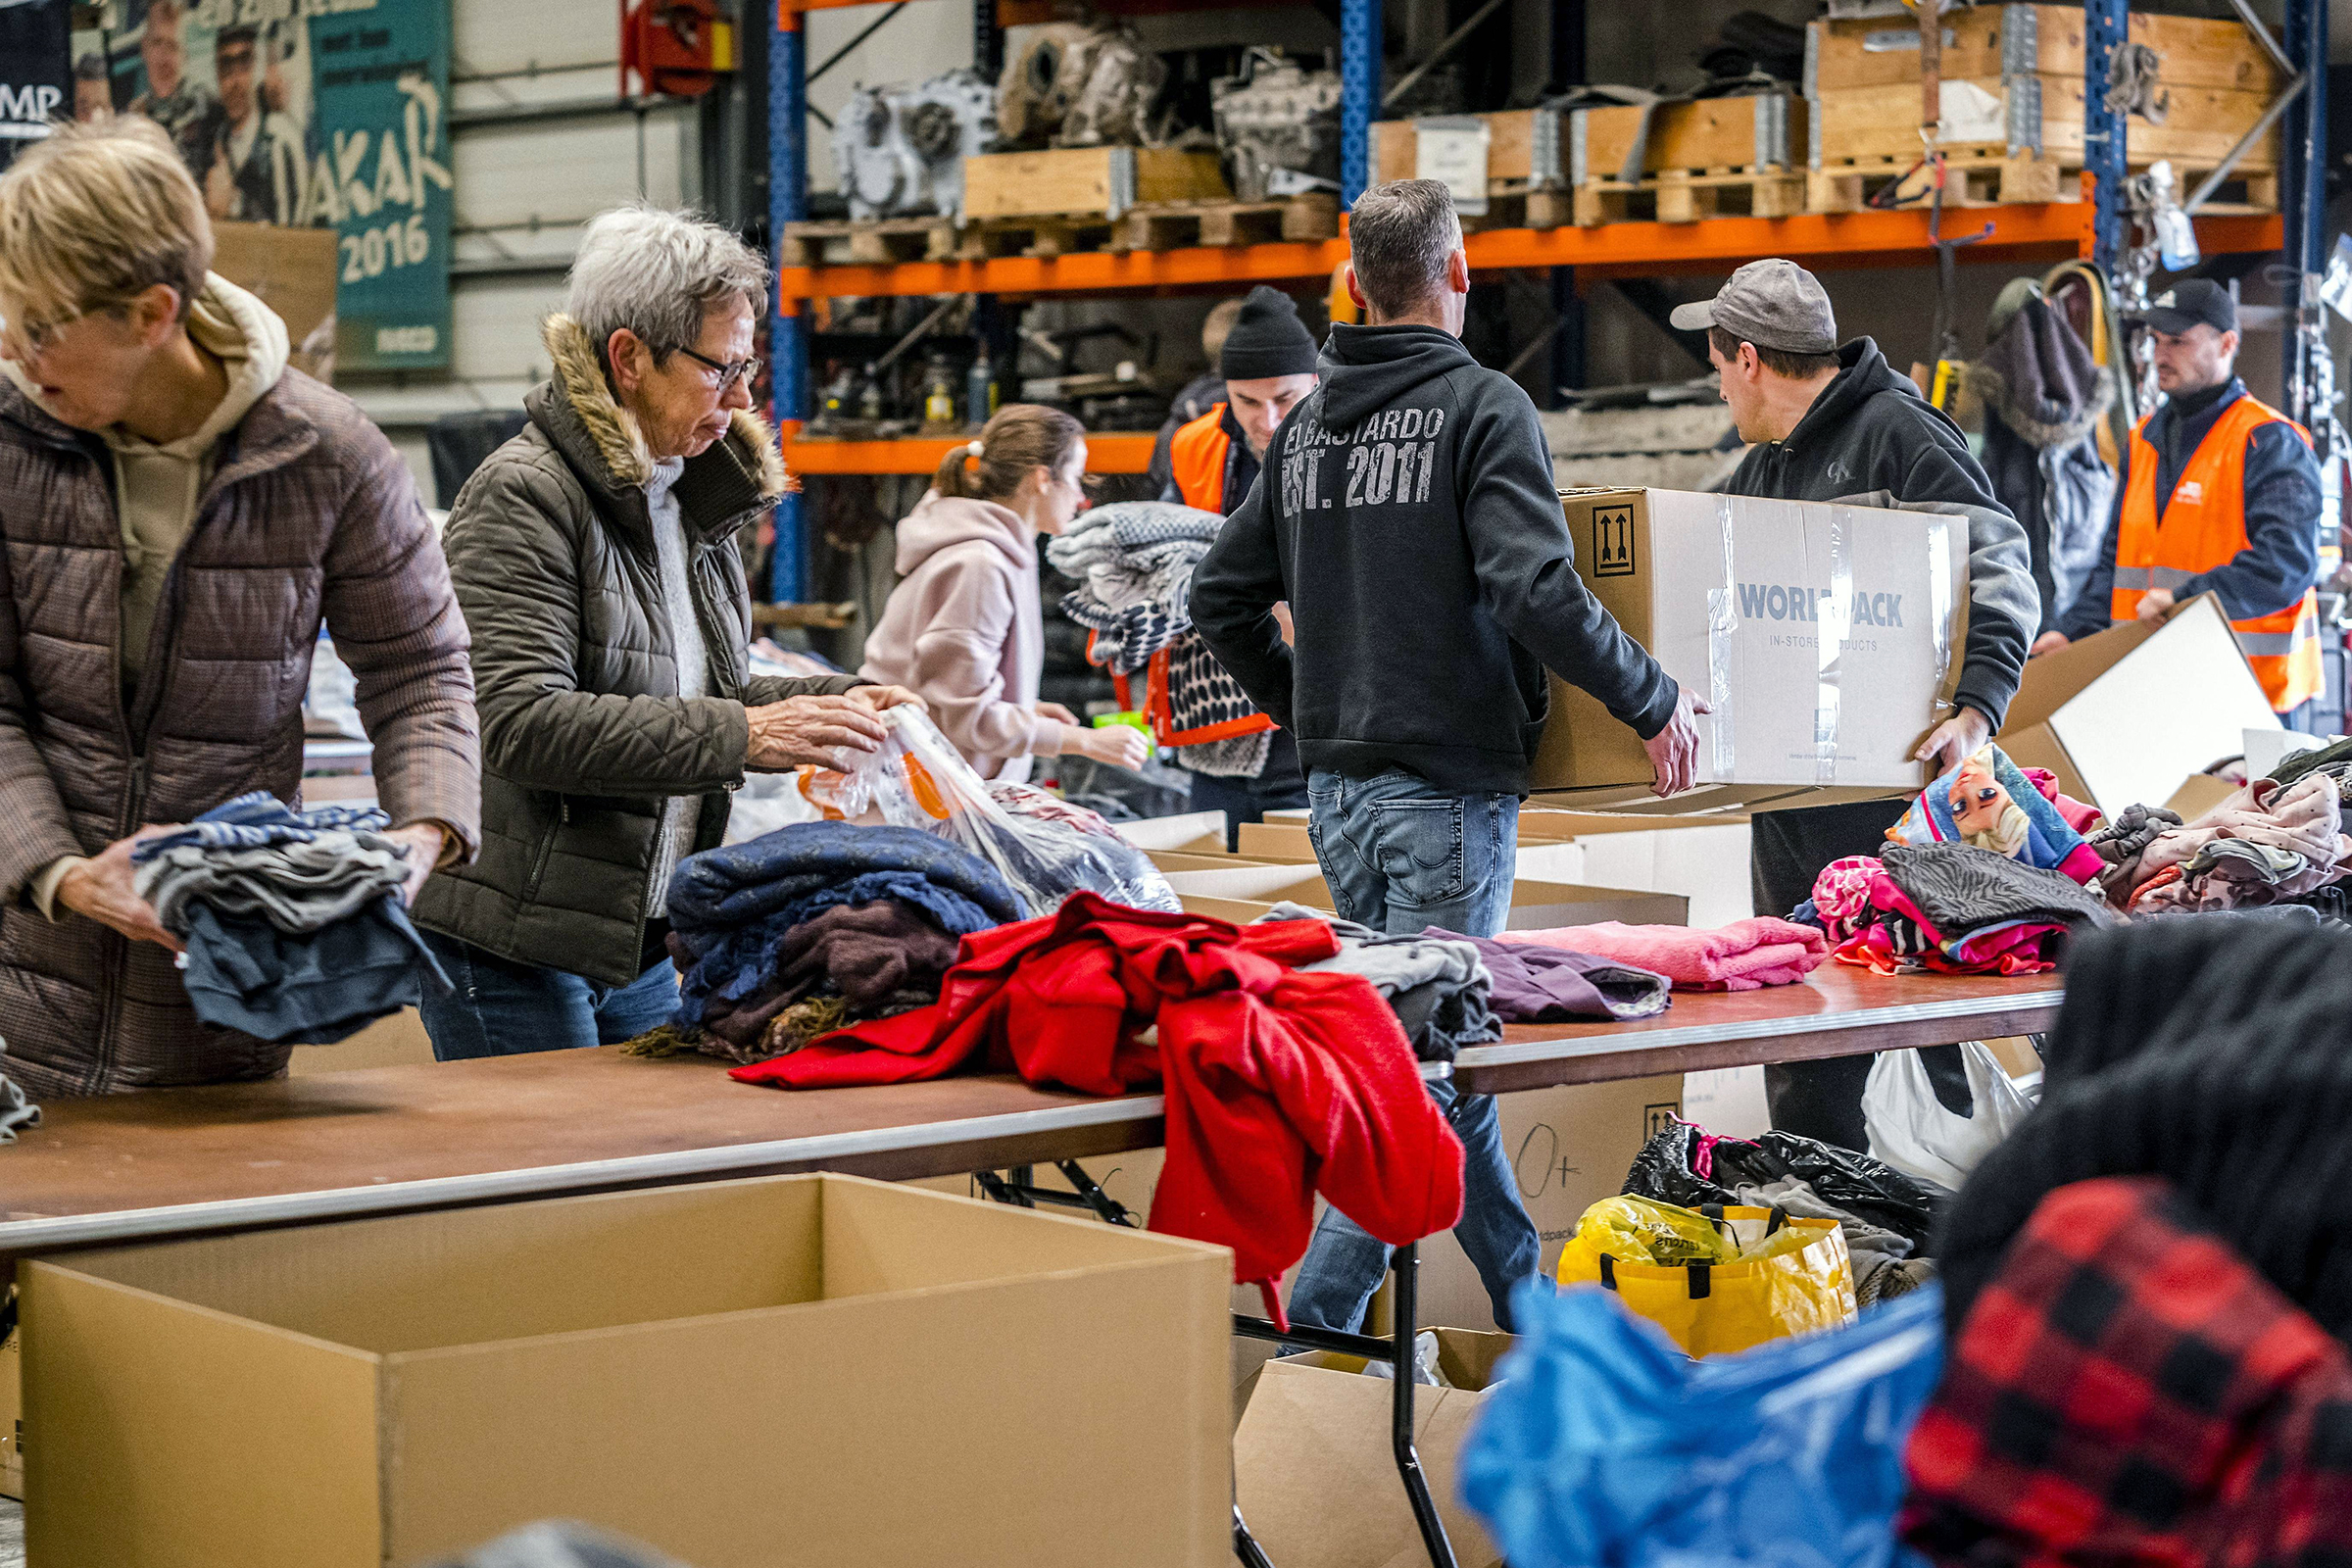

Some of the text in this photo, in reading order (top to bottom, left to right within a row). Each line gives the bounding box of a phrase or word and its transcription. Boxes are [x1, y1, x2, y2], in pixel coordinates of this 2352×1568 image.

[266, 74, 453, 227] DAKAR
[341, 214, 429, 283] 2016
[1281, 441, 1435, 518] EST. 2011
[1737, 582, 1904, 628] WORLACK
